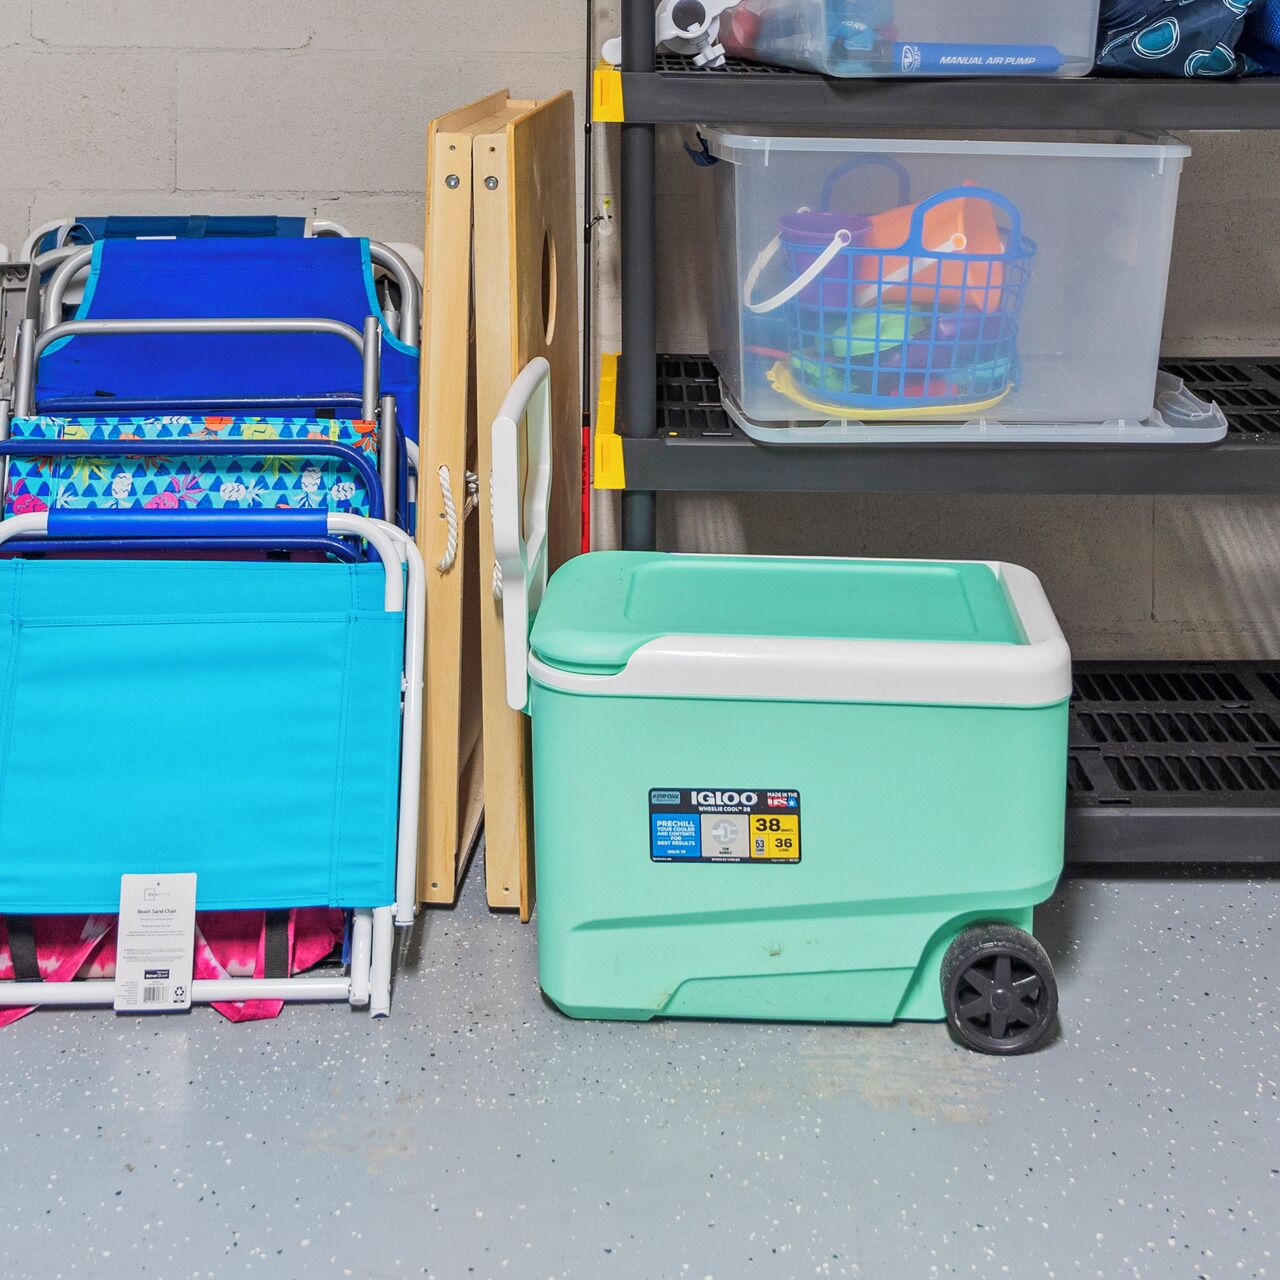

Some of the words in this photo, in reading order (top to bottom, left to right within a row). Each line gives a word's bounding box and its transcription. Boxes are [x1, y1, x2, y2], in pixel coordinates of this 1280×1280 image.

[939, 56, 985, 65] MANUAL
[985, 56, 1005, 65] AIR
[1004, 57, 1037, 65] PUMP
[691, 791, 758, 806] IGLOO
[755, 818, 781, 832] 38
[755, 839, 764, 848] 53
[775, 838, 793, 848] 36
